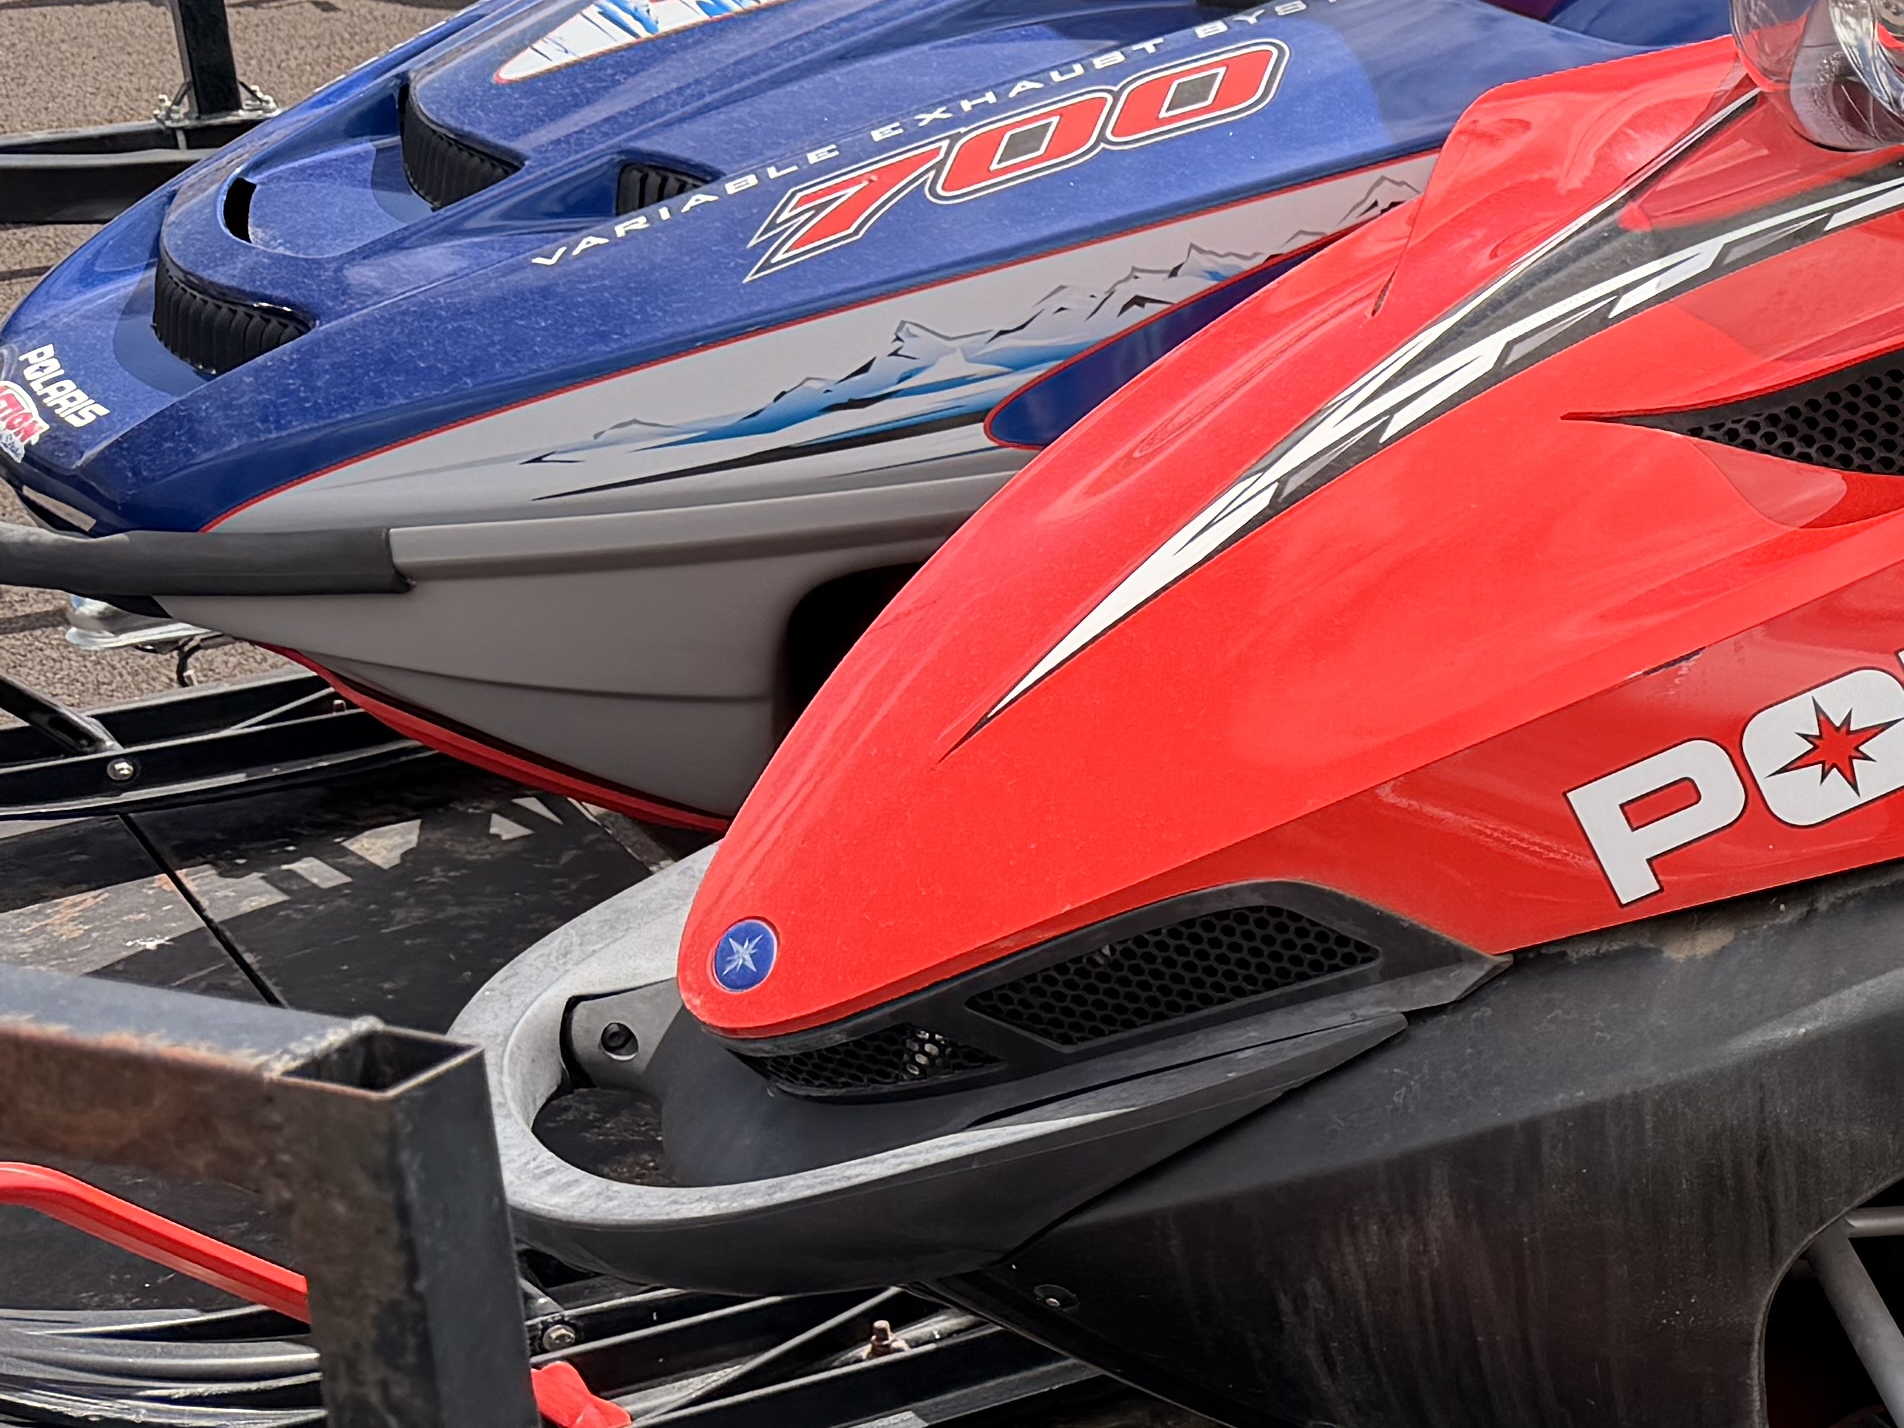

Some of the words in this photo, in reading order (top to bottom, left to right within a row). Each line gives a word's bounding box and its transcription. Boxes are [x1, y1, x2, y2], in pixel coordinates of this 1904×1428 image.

[531, 143, 839, 267] VARIABLE
[871, 38, 1164, 142] EXHAUST
[744, 39, 1290, 283] 700
[18, 343, 111, 428] POLARIS
